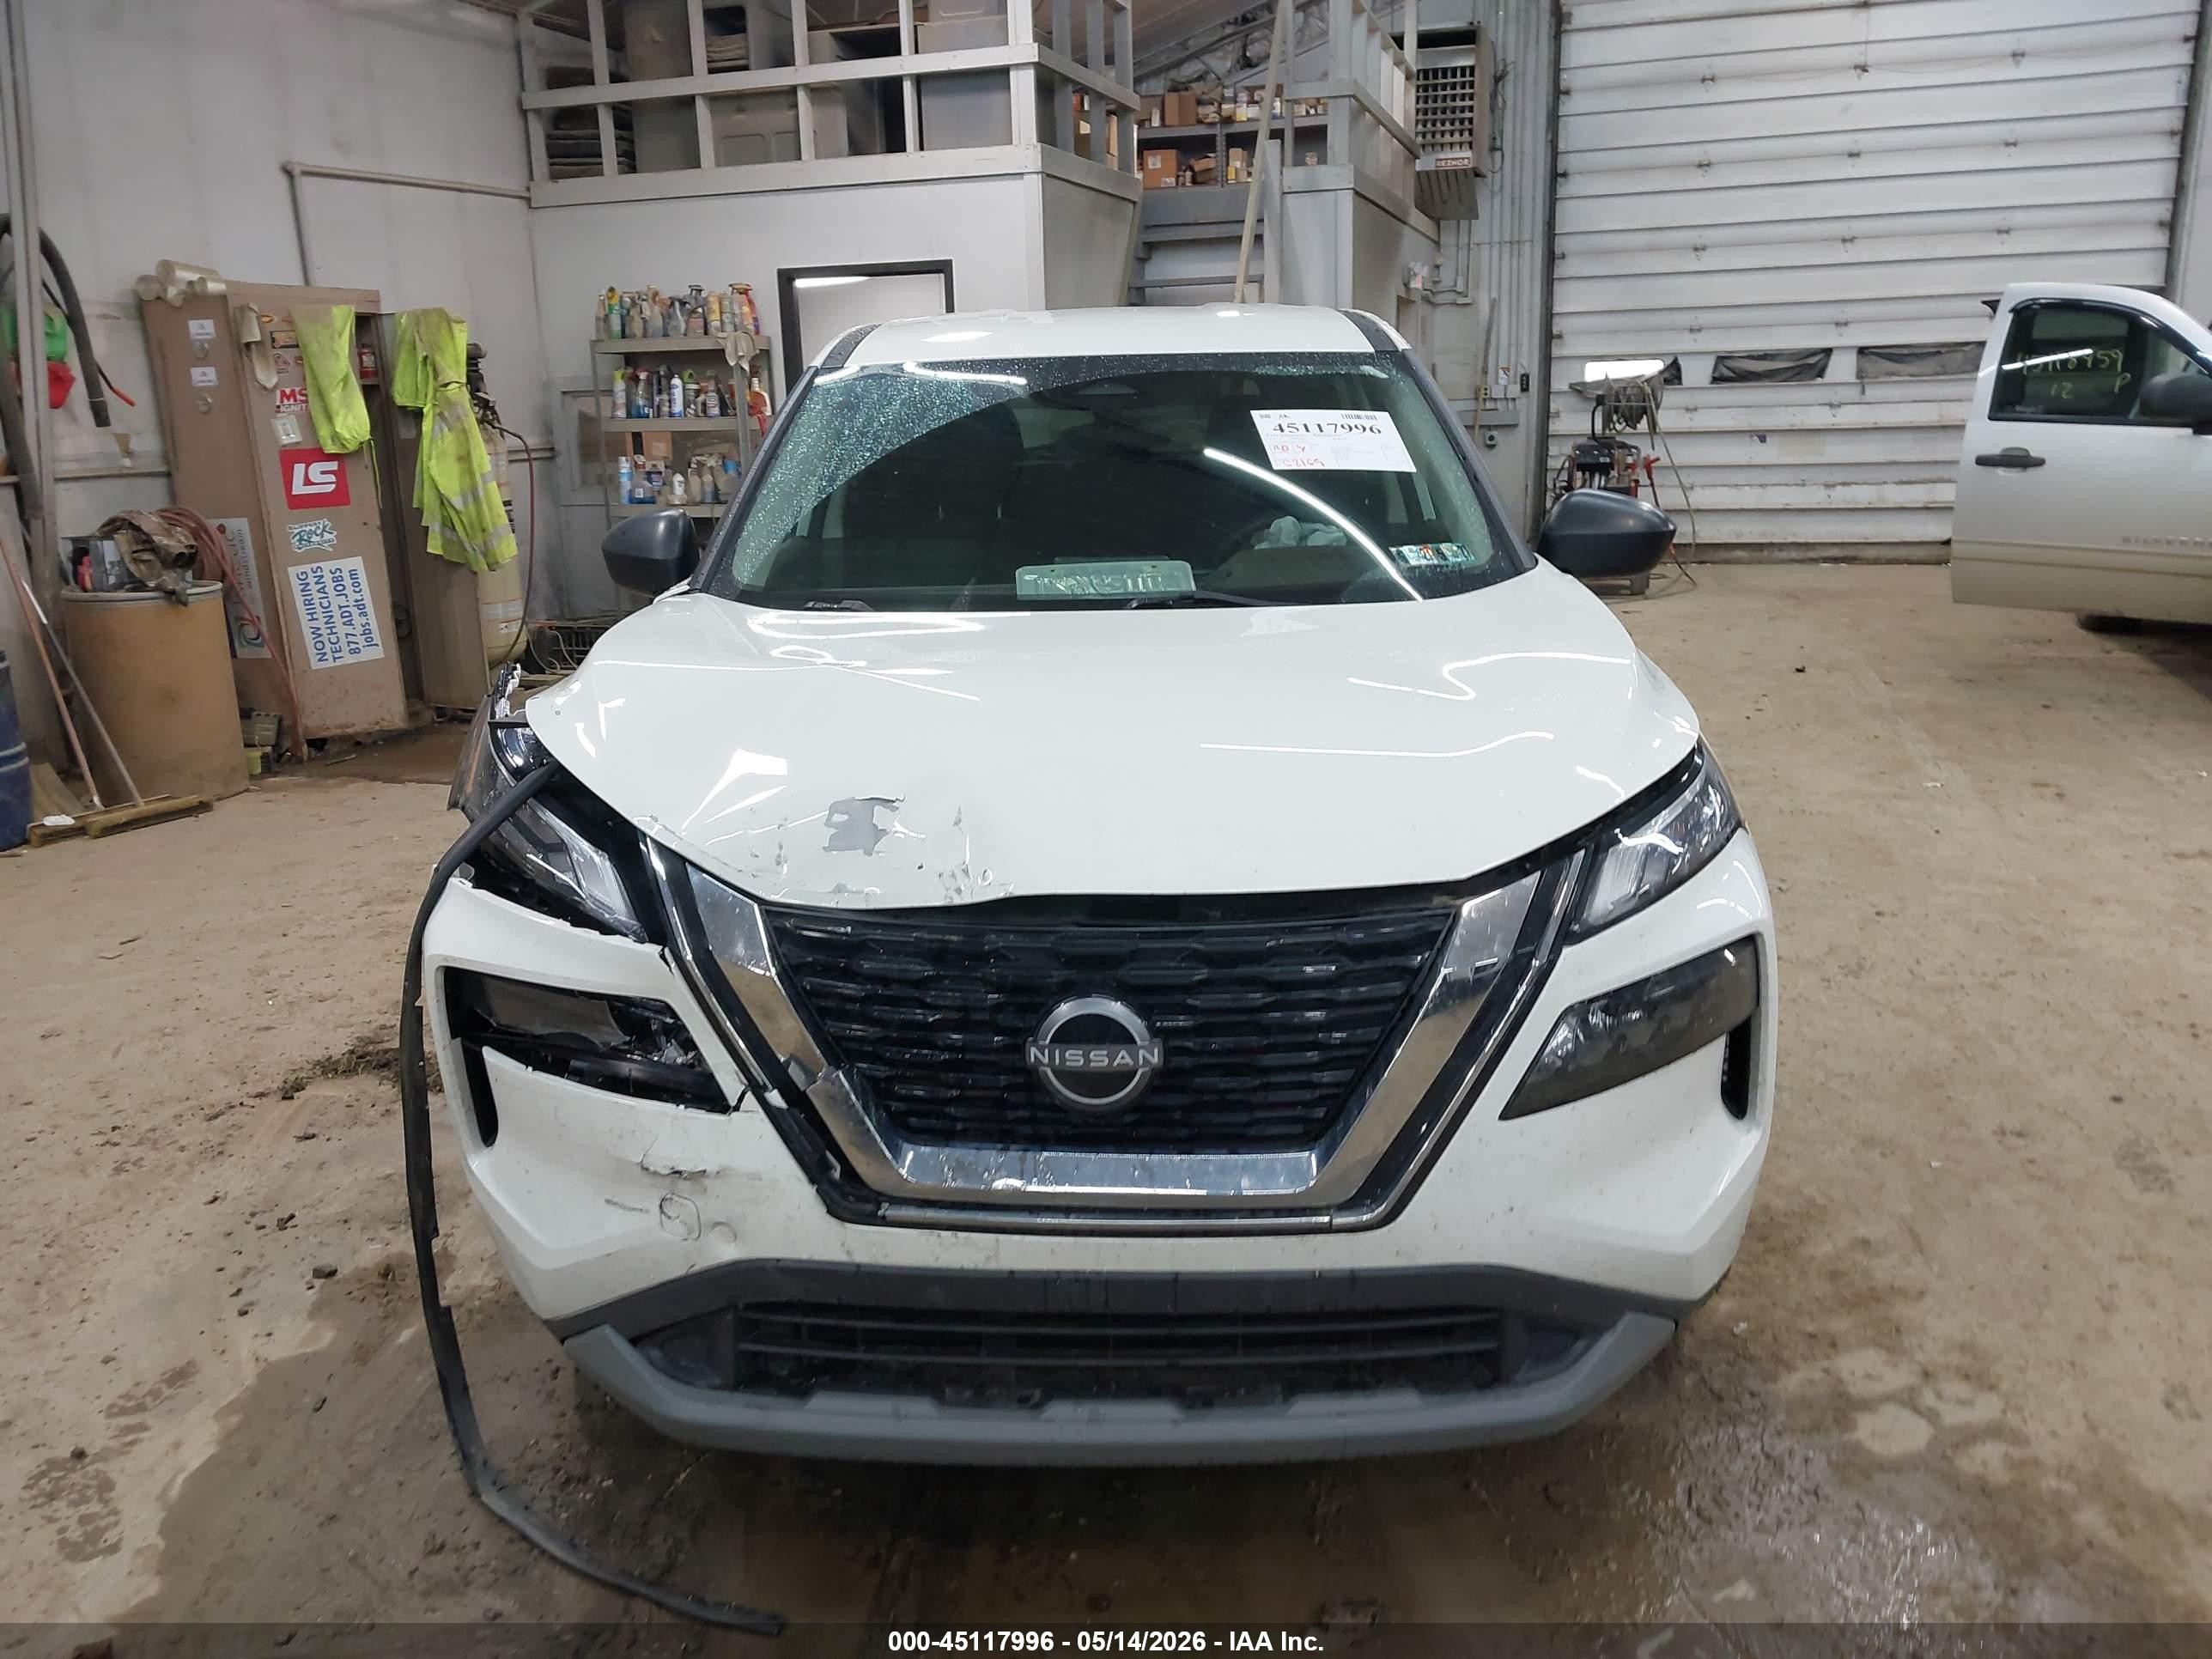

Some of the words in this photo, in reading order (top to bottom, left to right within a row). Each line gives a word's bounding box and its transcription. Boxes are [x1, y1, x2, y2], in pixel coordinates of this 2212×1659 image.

[1273, 422, 1382, 434] 45117996
[296, 570, 319, 622] HIRING
[311, 565, 344, 663] TECHNICIANS
[330, 568, 362, 655] 877.ADT.JOBS
[349, 568, 380, 648] jobs.adt.com
[309, 626, 329, 663] NOW
[1030, 1046, 1159, 1067] NISSAN
